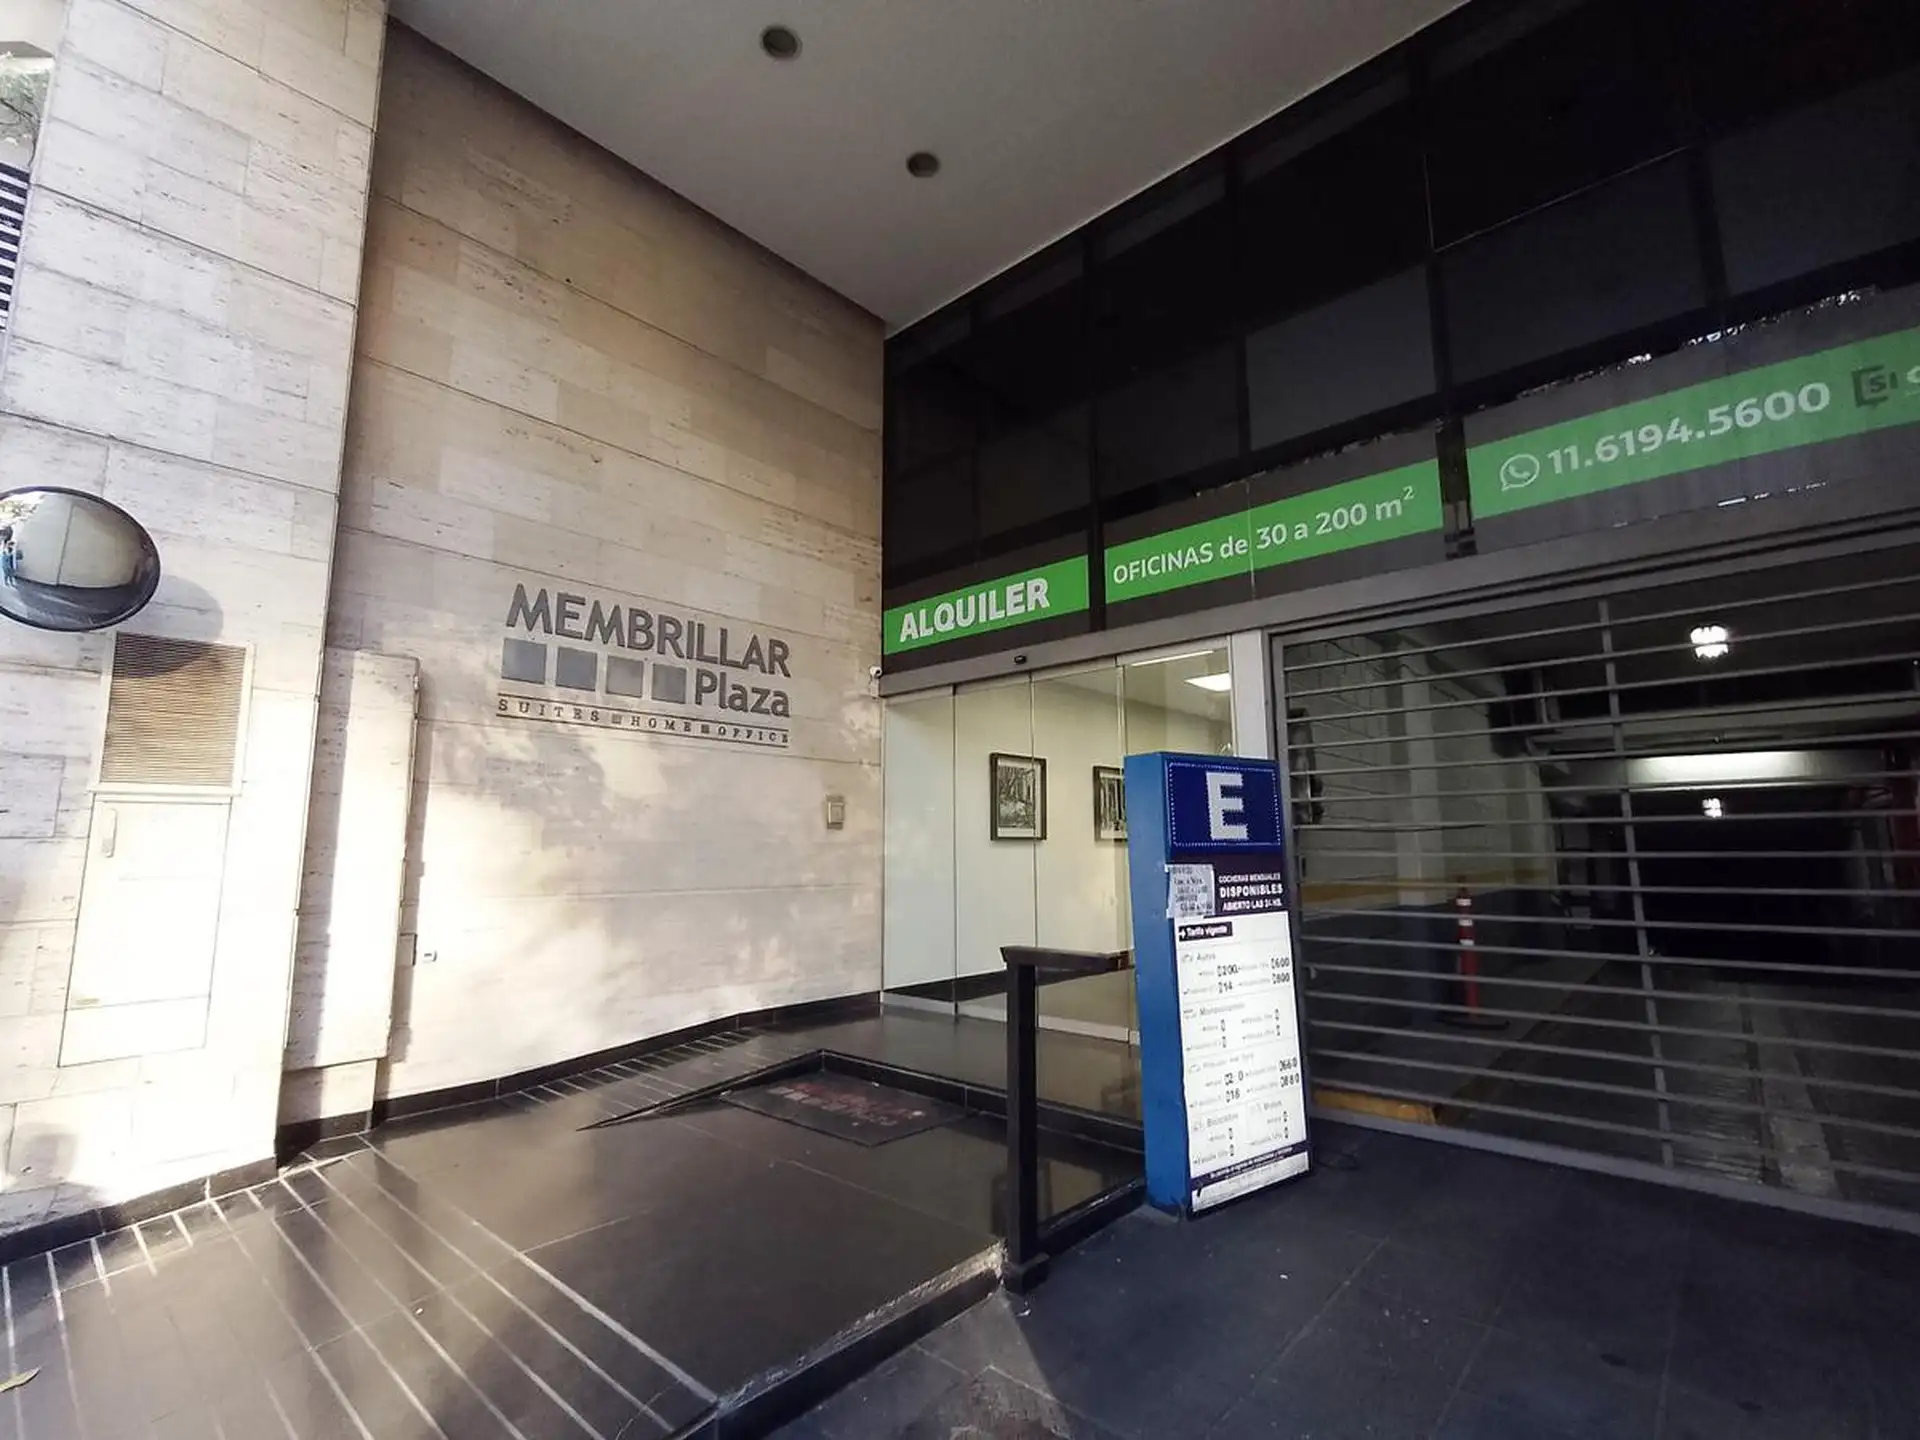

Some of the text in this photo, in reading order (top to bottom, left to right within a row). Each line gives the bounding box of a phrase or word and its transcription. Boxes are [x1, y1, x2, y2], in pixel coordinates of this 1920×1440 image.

[1548, 381, 1831, 475] 11.6194.5600
[1113, 542, 1214, 585] OFICINAS
[1219, 535, 1249, 561] de
[1256, 523, 1287, 551] 30
[1293, 523, 1308, 541] a
[1315, 502, 1368, 535] 200
[506, 582, 791, 678] MEMBRILLAR
[899, 577, 1050, 644] ALQUILER
[498, 698, 790, 744] SUITES HOME OFFICE
[694, 668, 791, 718] Plaza
[1206, 771, 1250, 841] E
[1220, 883, 1284, 899] DISPONIBLES
